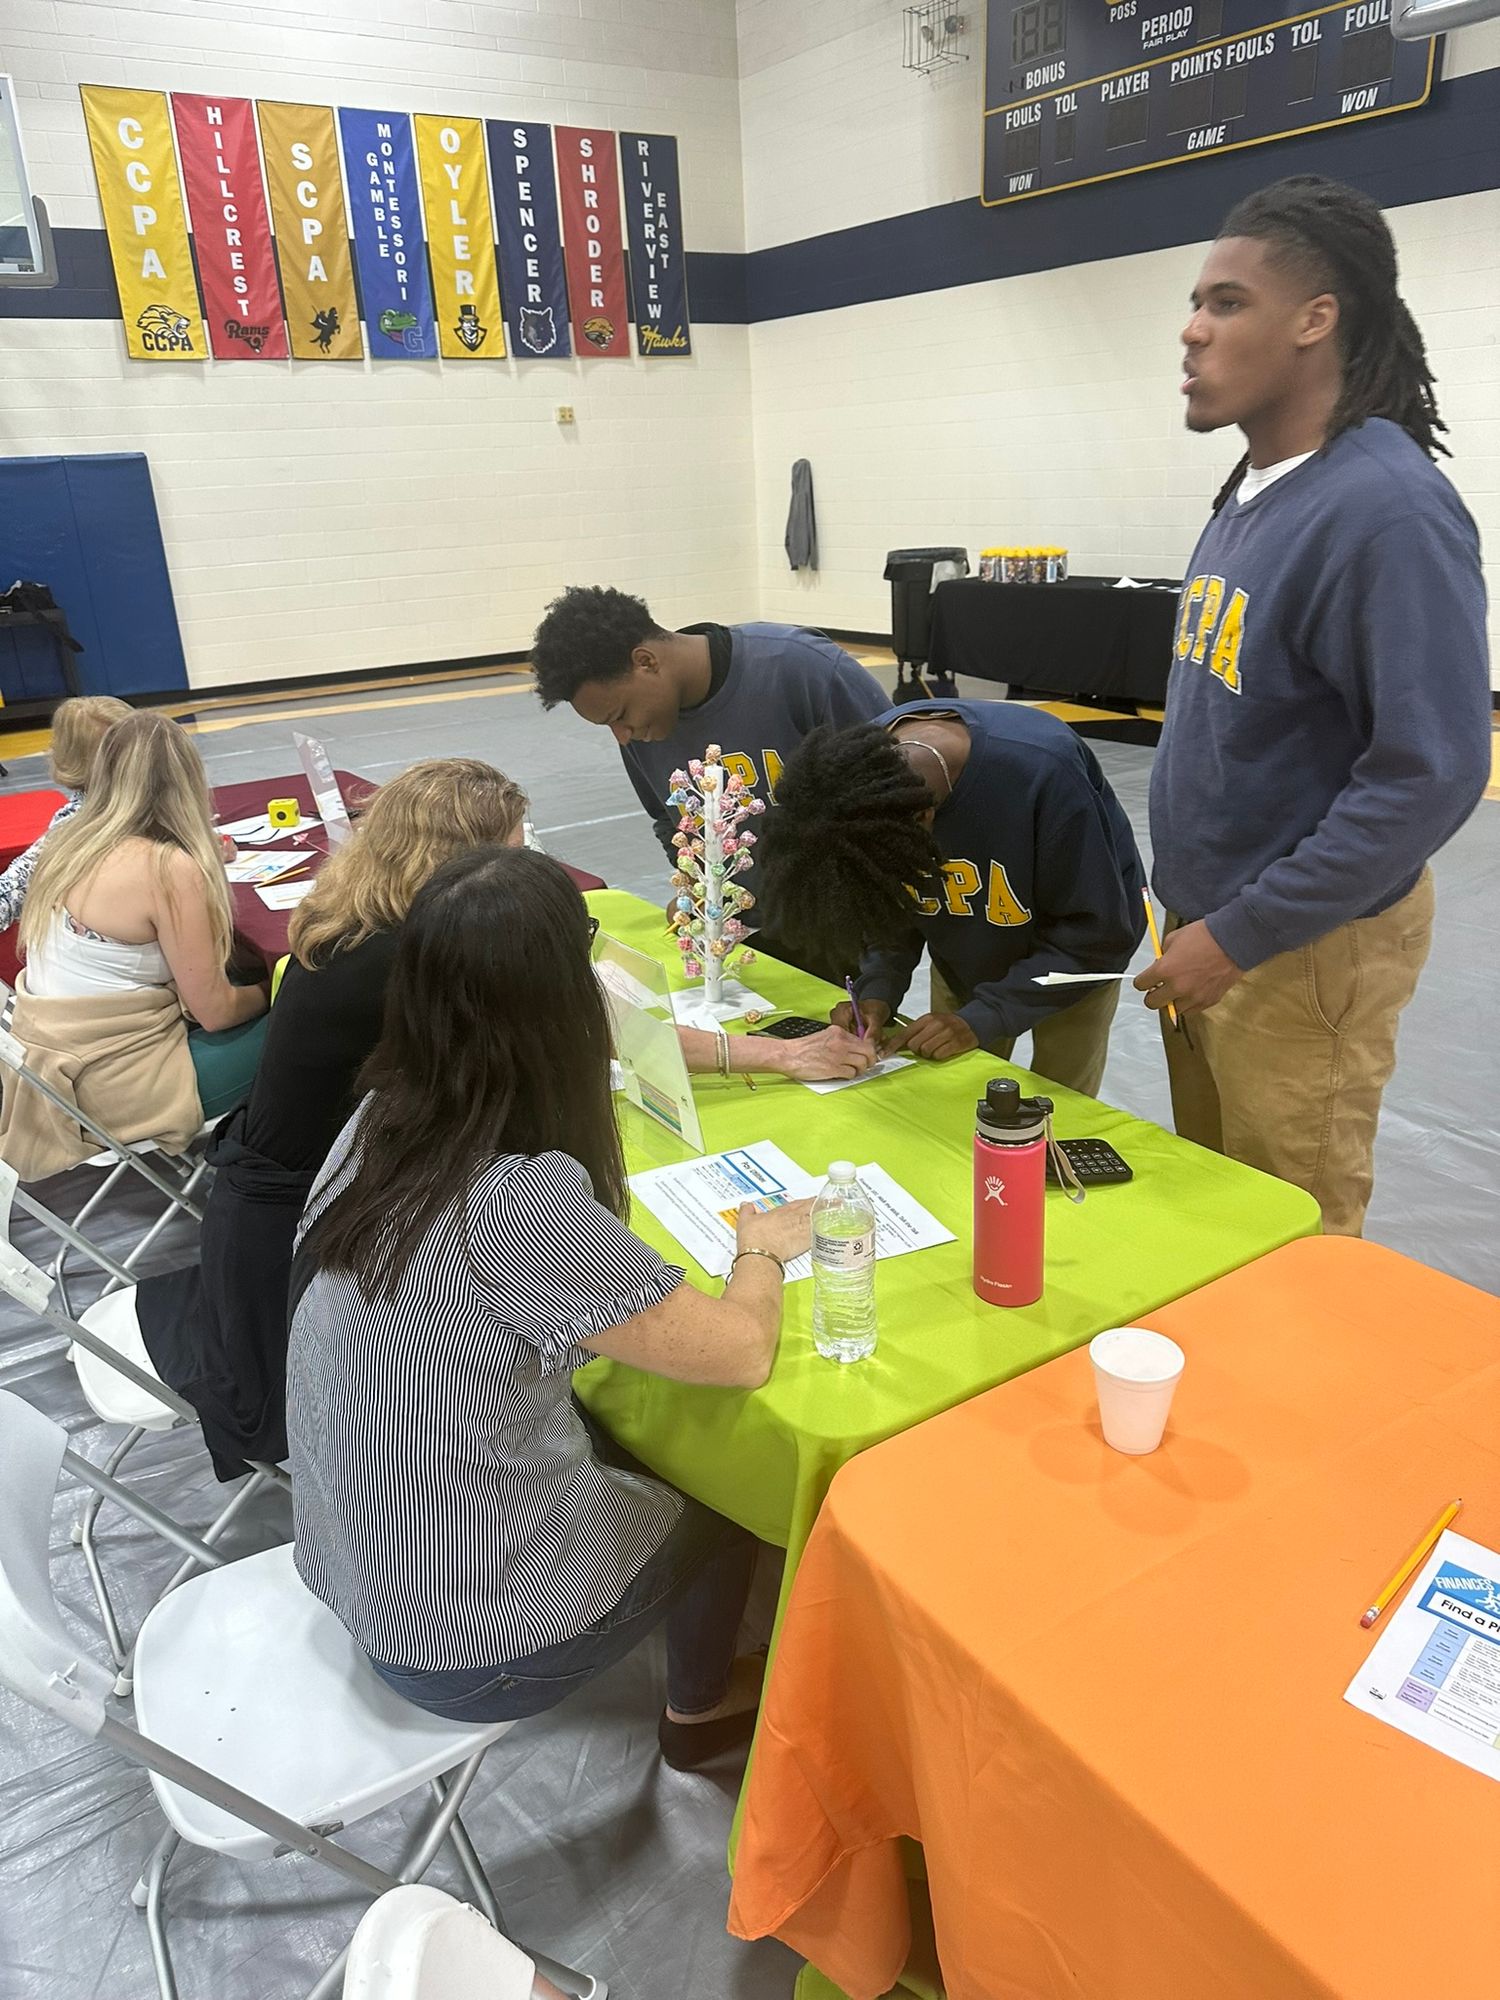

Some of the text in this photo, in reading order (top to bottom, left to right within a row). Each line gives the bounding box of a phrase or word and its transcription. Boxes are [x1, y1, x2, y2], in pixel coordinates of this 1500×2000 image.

[1109, 1, 1138, 22] POSS
[1141, 6, 1194, 40] PERIOD
[1143, 28, 1189, 49] FAIR PLAY
[1005, 0, 1391, 130] FOULS TOL PLAYER POINTS FOULS TOL FOUL
[1025, 60, 1066, 90] BONUS
[1008, 86, 1379, 193] WON GAME WON
[117, 117, 167, 280] CCPA
[206, 106, 249, 316] HILLCREST
[291, 142, 328, 282] SCPA
[366, 152, 390, 258] GAMBLE
[377, 123, 409, 300] MONTESSORI
[439, 127, 475, 296] OYLER
[513, 128, 542, 303] SPENCER
[580, 138, 605, 308] SHRODER
[637, 140, 662, 319] RIVERVIEW
[657, 192, 669, 269] EAST
[142, 331, 194, 352] CCPA
[224, 319, 270, 339] Rams
[641, 324, 688, 354] Hawks
[1174, 574, 1250, 695] CPA
[898, 858, 1033, 927] CPA
[1434, 1576, 1495, 1591] FINANCES
[1441, 1599, 1473, 1620] Find
[1474, 1616, 1486, 1626] a
